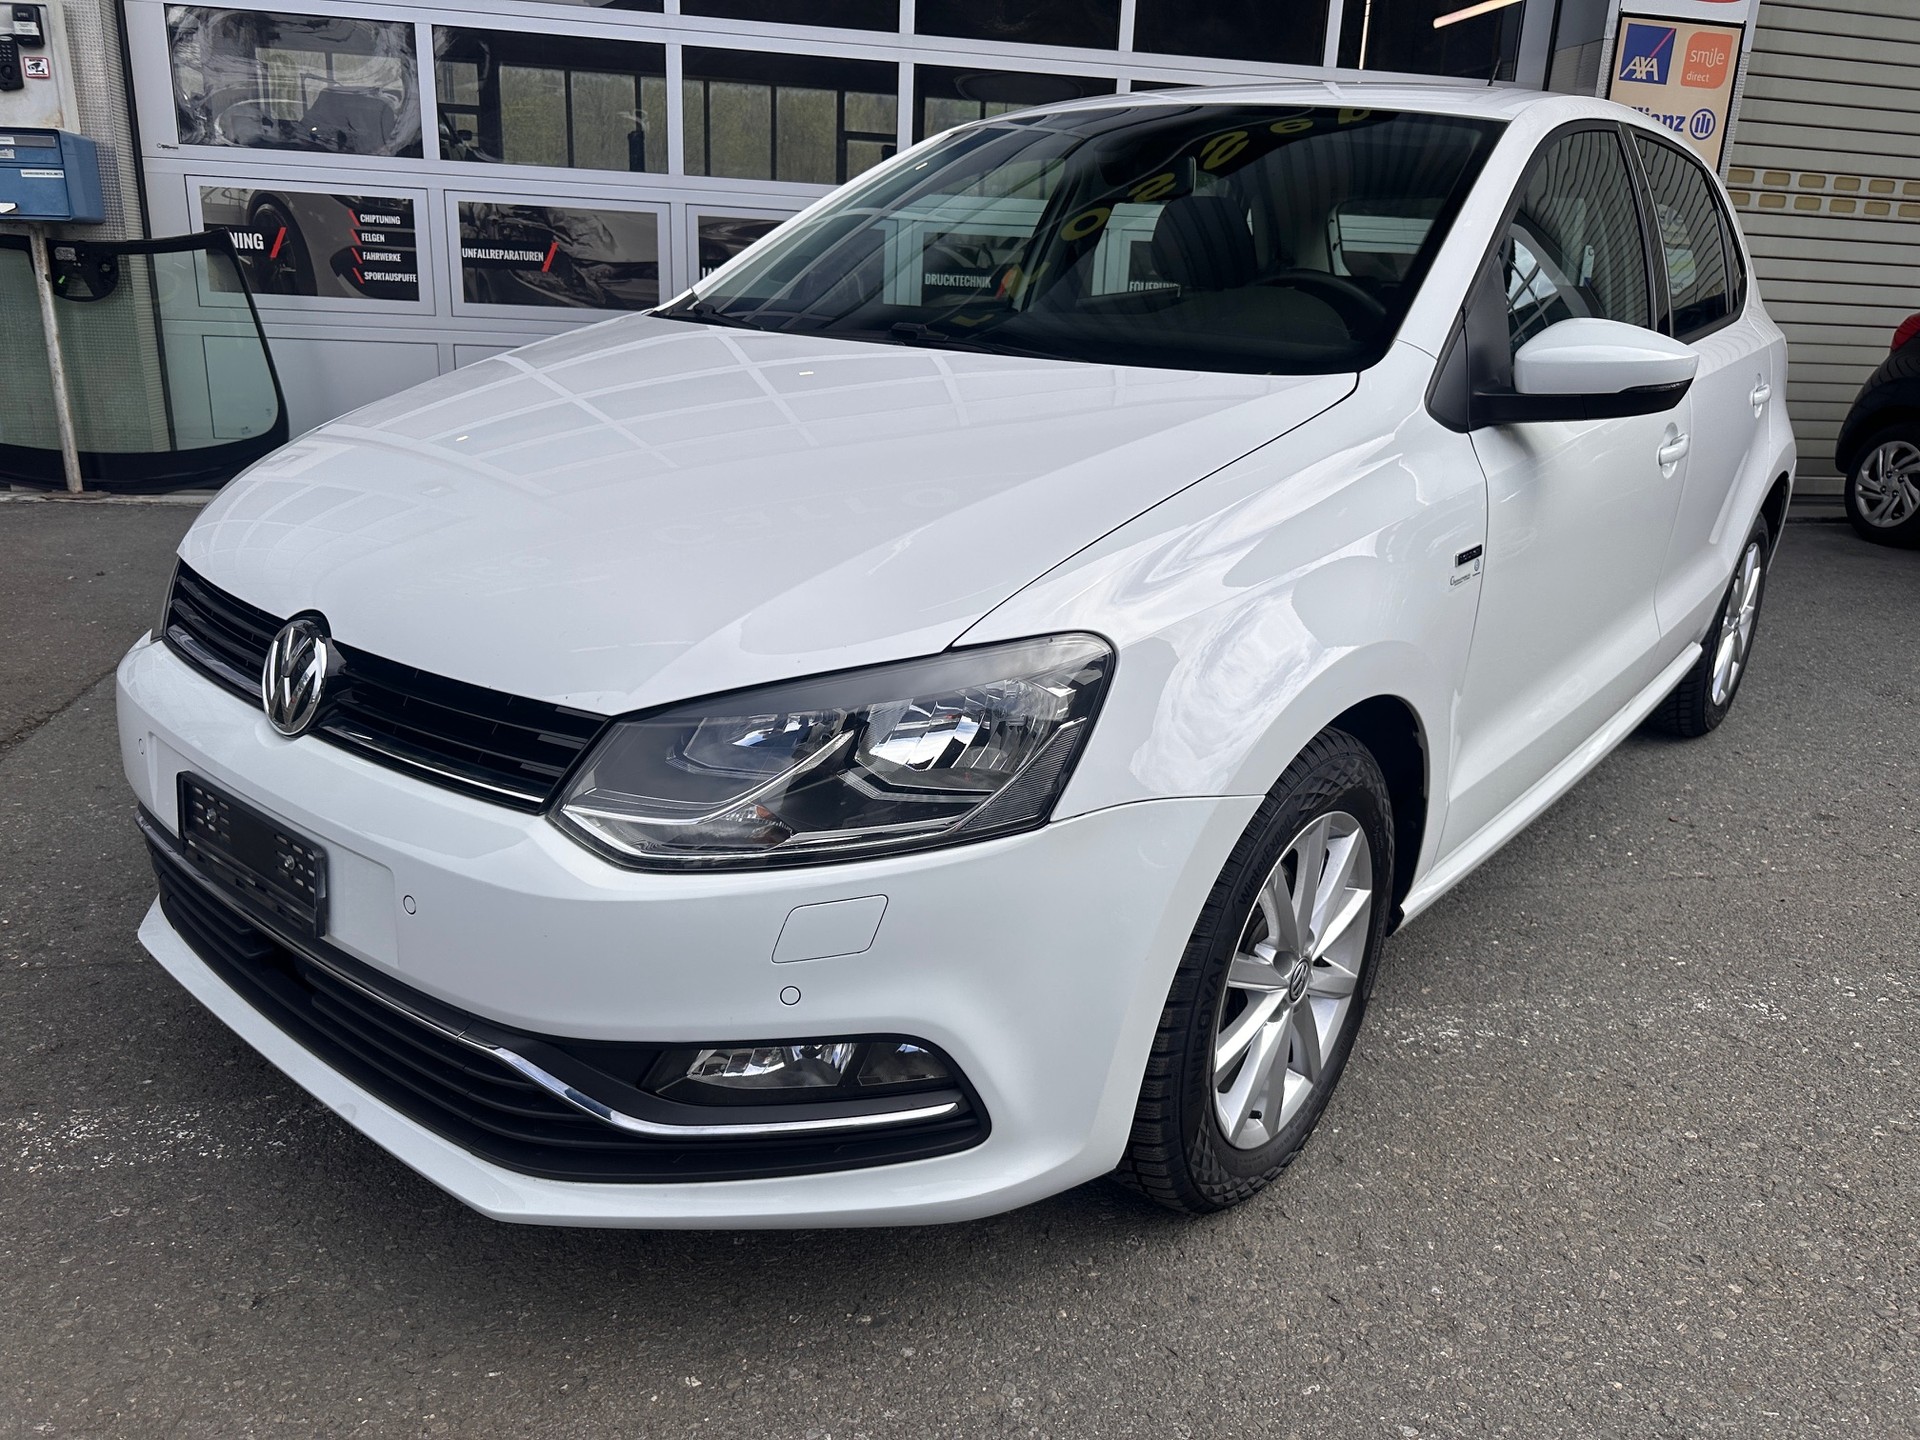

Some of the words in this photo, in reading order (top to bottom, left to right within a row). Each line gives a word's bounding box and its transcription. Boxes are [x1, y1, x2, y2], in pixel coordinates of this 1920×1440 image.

[1690, 48, 1725, 68] smile
[1620, 56, 1659, 81] AXA
[1686, 71, 1710, 83] direct
[360, 214, 401, 225] CHIPTUNING
[230, 231, 264, 250] NING
[361, 232, 385, 243] FELGEN
[363, 251, 402, 263] FAHRWERKE
[462, 248, 544, 261] UNFALLREPARATUREN
[364, 272, 418, 284] SPORTAUSPUFFE
[924, 273, 992, 289] DRUCKTECHNIK
